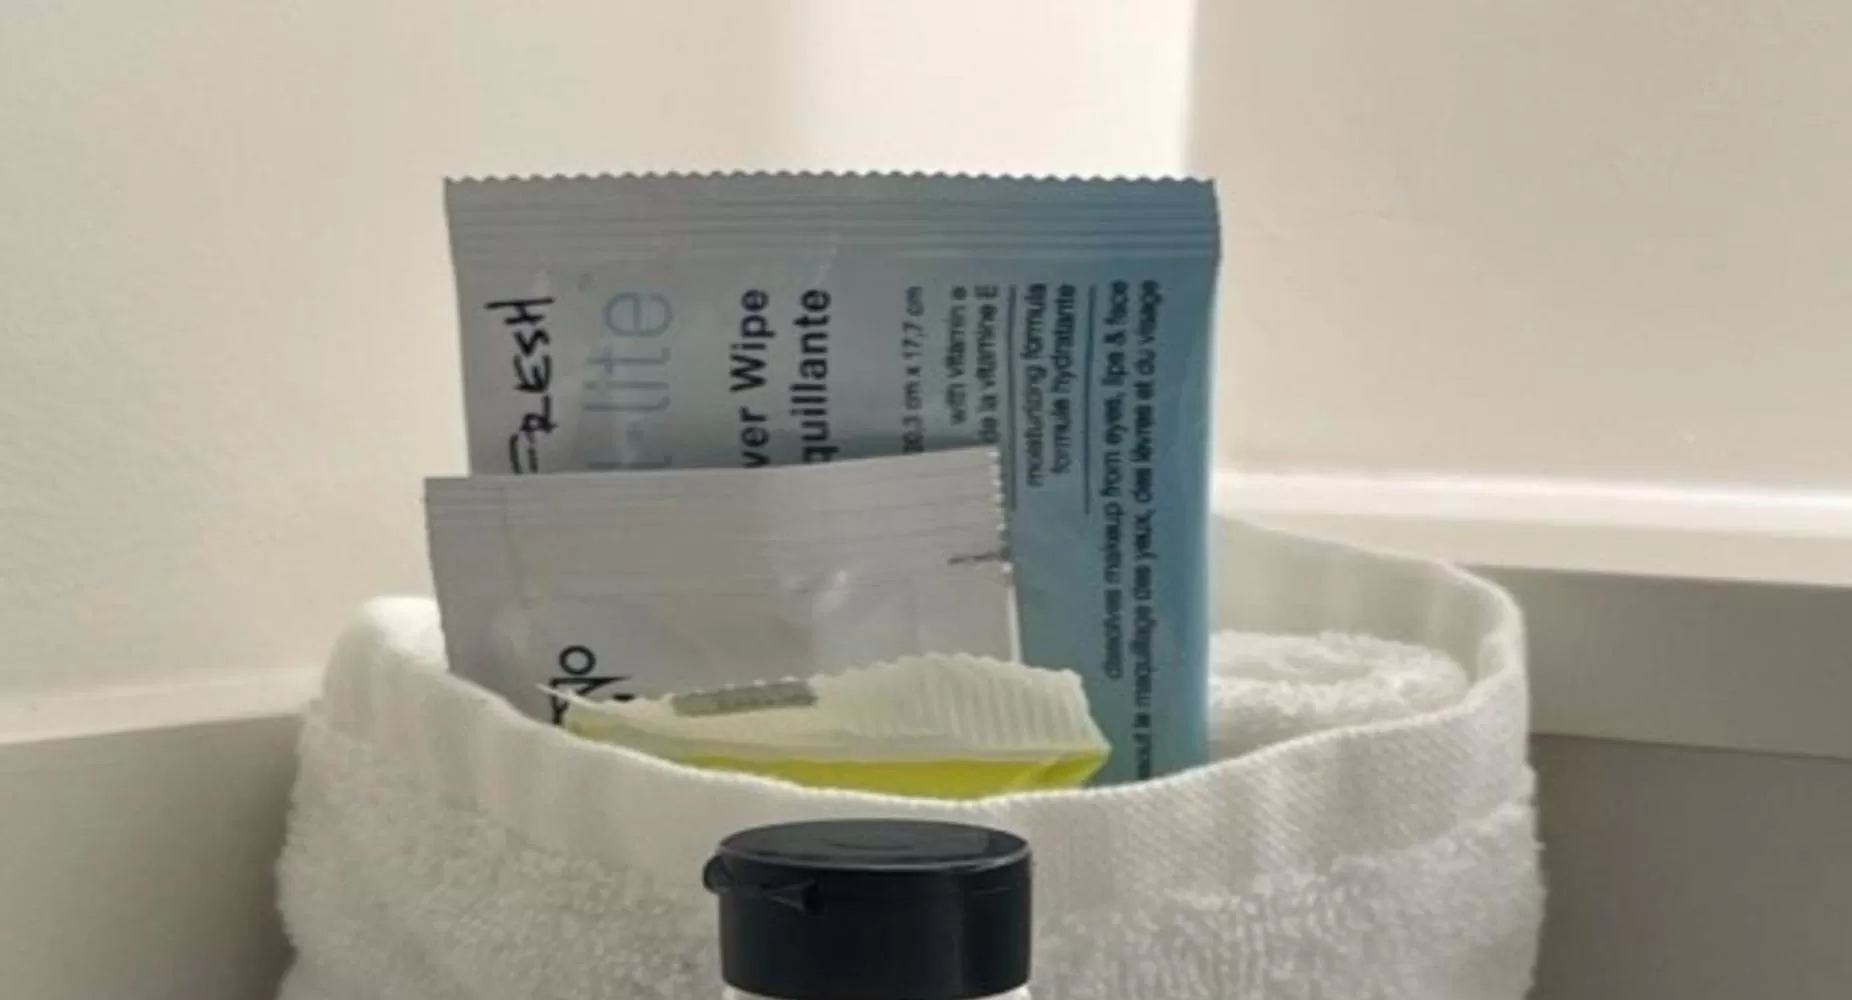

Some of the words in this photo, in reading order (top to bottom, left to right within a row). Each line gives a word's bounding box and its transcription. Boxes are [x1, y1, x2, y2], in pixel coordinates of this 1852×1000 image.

[905, 285, 924, 316] cm
[974, 284, 999, 299] E
[1104, 279, 1129, 325] face
[1138, 280, 1164, 345] visage
[729, 288, 776, 392] Wipe
[902, 321, 926, 359] 17,7
[945, 305, 966, 378] vitamin
[1020, 283, 1047, 360] formula
[1050, 283, 1076, 394] hydratante
[1102, 330, 1127, 347] &
[975, 304, 999, 389] vitamine
[1102, 351, 1129, 386] lips
[1133, 349, 1156, 376] du
[905, 381, 922, 410] cm
[946, 383, 966, 425] with
[976, 394, 998, 413] la
[1024, 365, 1047, 487] moisturizing
[1050, 398, 1072, 474] formule
[1100, 452, 1122, 497] from
[1099, 501, 1124, 584] makeup
